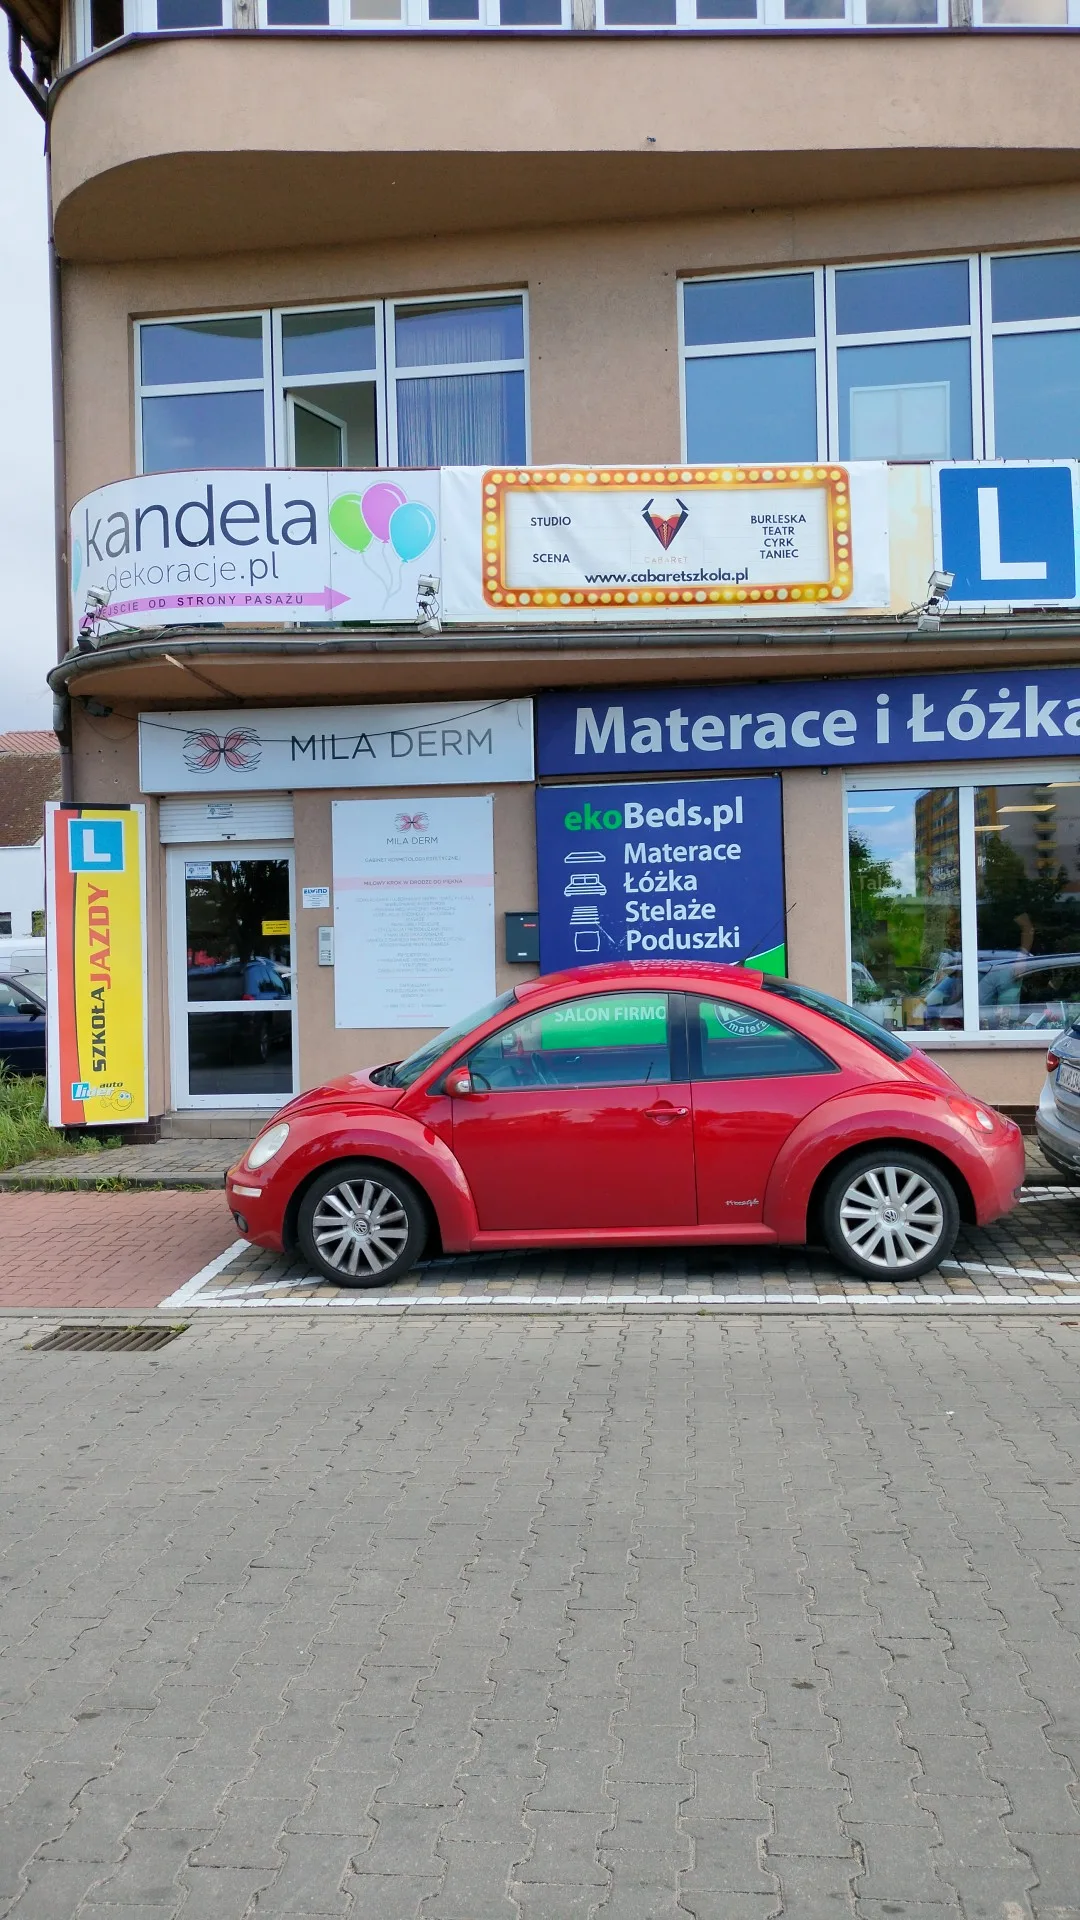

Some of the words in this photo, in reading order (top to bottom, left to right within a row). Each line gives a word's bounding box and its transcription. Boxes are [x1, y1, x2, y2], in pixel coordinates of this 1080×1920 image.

[84, 483, 318, 567] kandela
[530, 516, 572, 527] STUDIO
[750, 514, 807, 525] BURLESKA
[762, 526, 796, 536] TEATR
[764, 538, 794, 548] CYRK
[977, 487, 1047, 580] L
[532, 553, 571, 564] SCENA
[759, 549, 799, 560] TANIEC
[106, 551, 279, 592] dekoracje.pl
[584, 567, 749, 585] www.cabaretszkola.pl
[148, 598, 166, 609] OD
[177, 595, 236, 606] STRONY
[245, 593, 303, 605] PASAŻU
[574, 705, 858, 756] Materace
[875, 693, 891, 744] i
[291, 732, 376, 761] MILA
[390, 727, 493, 758] DERM
[564, 796, 743, 832] ekoBeds.pl
[83, 828, 111, 862] L
[386, 837, 409, 846] MILA
[411, 836, 439, 845] DERM
[624, 842, 742, 865] Materace
[623, 869, 698, 893] Łóżka
[625, 898, 716, 923] Stelaże
[87, 882, 112, 989] JAZDY
[626, 925, 740, 952] Poduszki
[554, 1007, 610, 1023] SALON
[90, 986, 107, 1072] SZKOŁA
